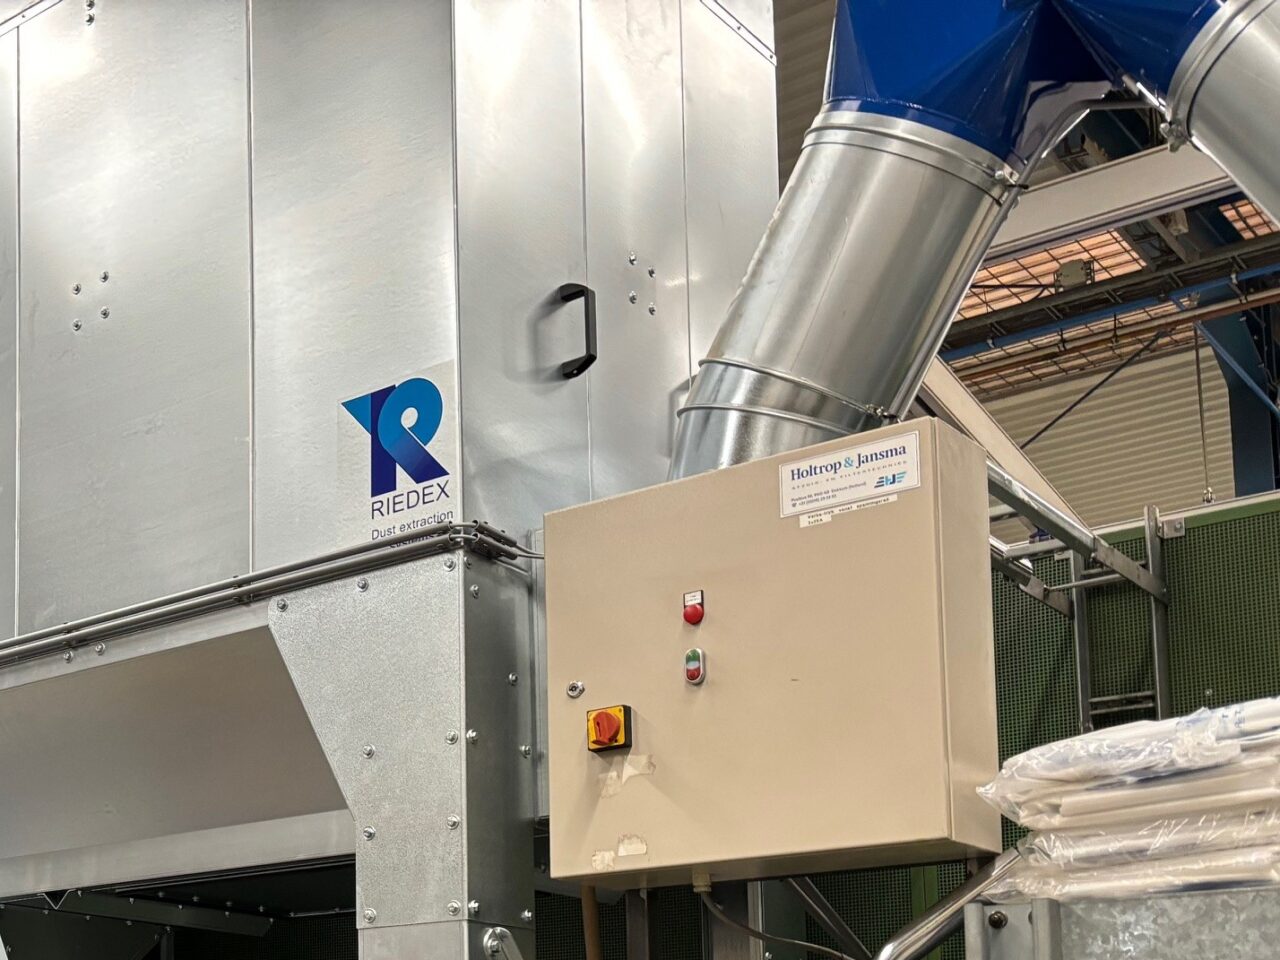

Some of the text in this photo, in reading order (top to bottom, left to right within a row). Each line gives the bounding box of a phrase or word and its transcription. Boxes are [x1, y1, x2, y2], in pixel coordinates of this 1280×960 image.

[791, 445, 907, 481] Holtrop & Jansma
[371, 479, 450, 519] RIEDEX
[371, 510, 454, 541] Dust extraction
